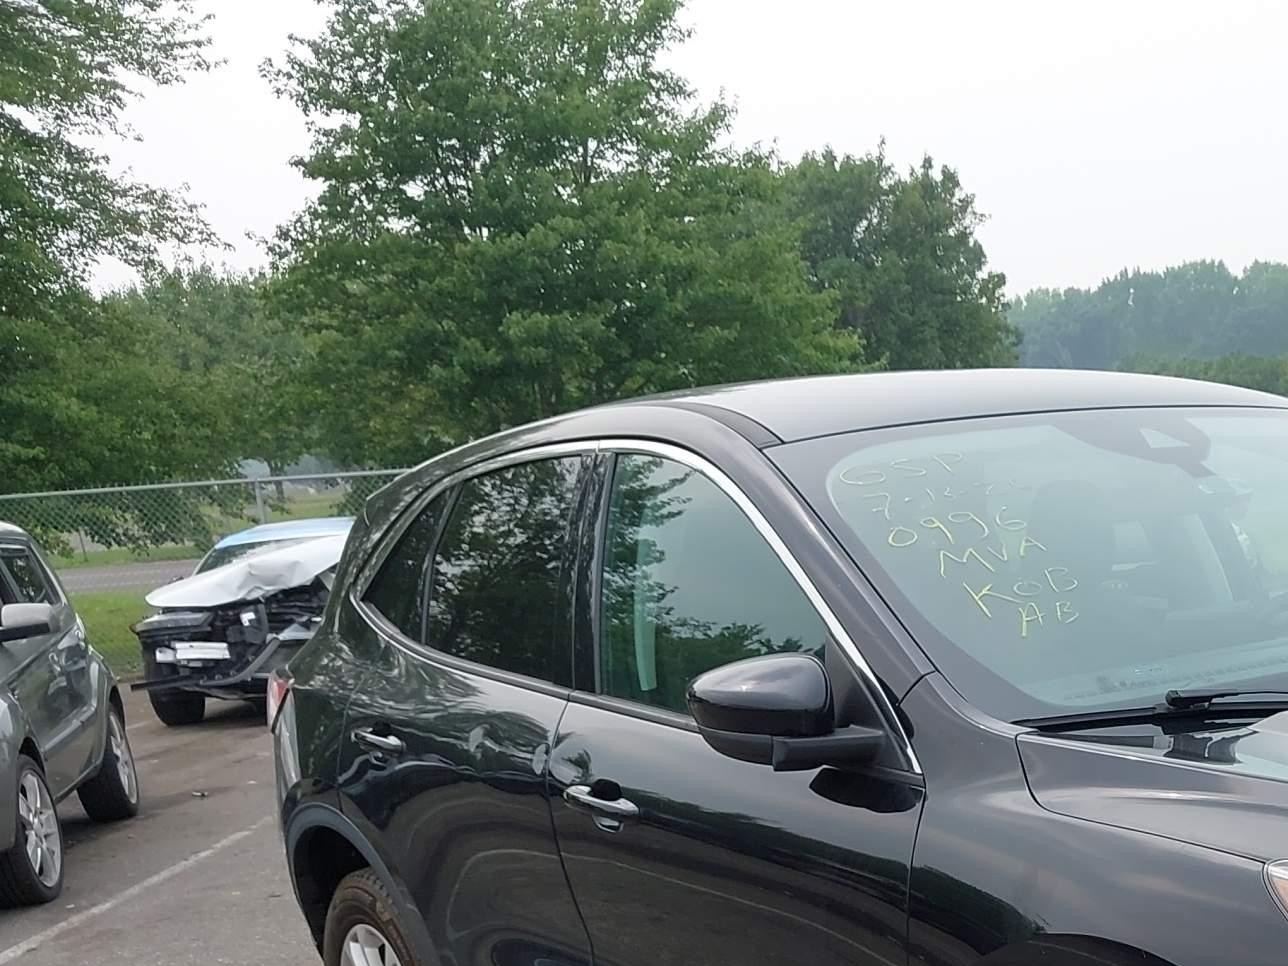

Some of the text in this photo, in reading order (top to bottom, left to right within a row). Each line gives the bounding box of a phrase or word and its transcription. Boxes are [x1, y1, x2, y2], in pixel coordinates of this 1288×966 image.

[888, 505, 1027, 547] 0996
[939, 536, 1047, 578] MVA
[962, 567, 1079, 619] KOB
